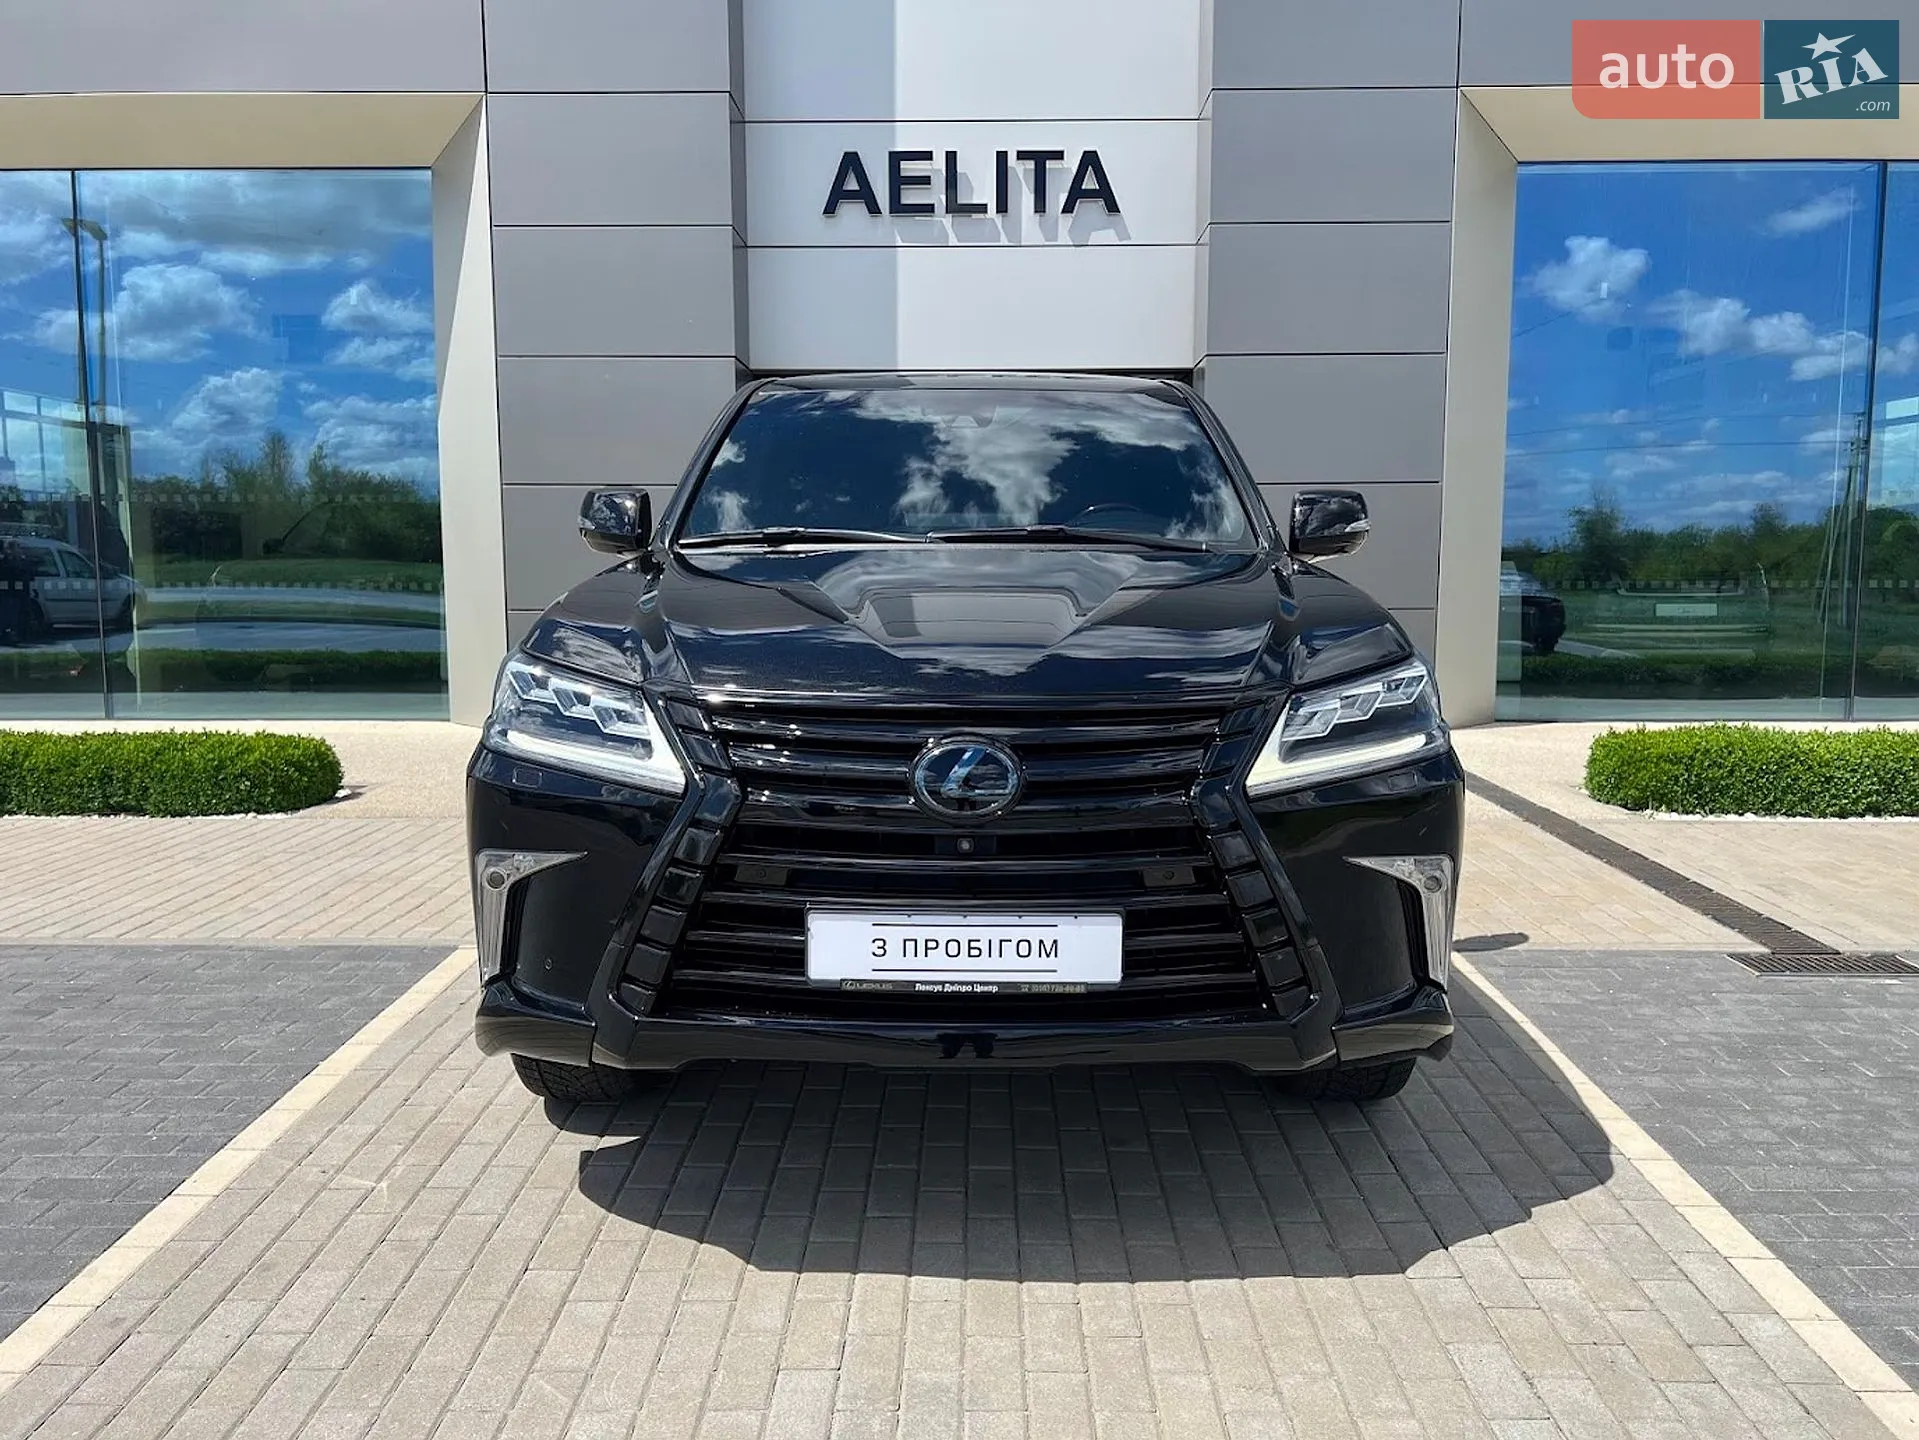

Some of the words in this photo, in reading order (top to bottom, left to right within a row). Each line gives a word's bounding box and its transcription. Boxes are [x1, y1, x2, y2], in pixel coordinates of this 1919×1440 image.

[822, 150, 1121, 215] AELITA
[871, 938, 887, 958] З
[903, 938, 1059, 958] ПРОБІГОМ
